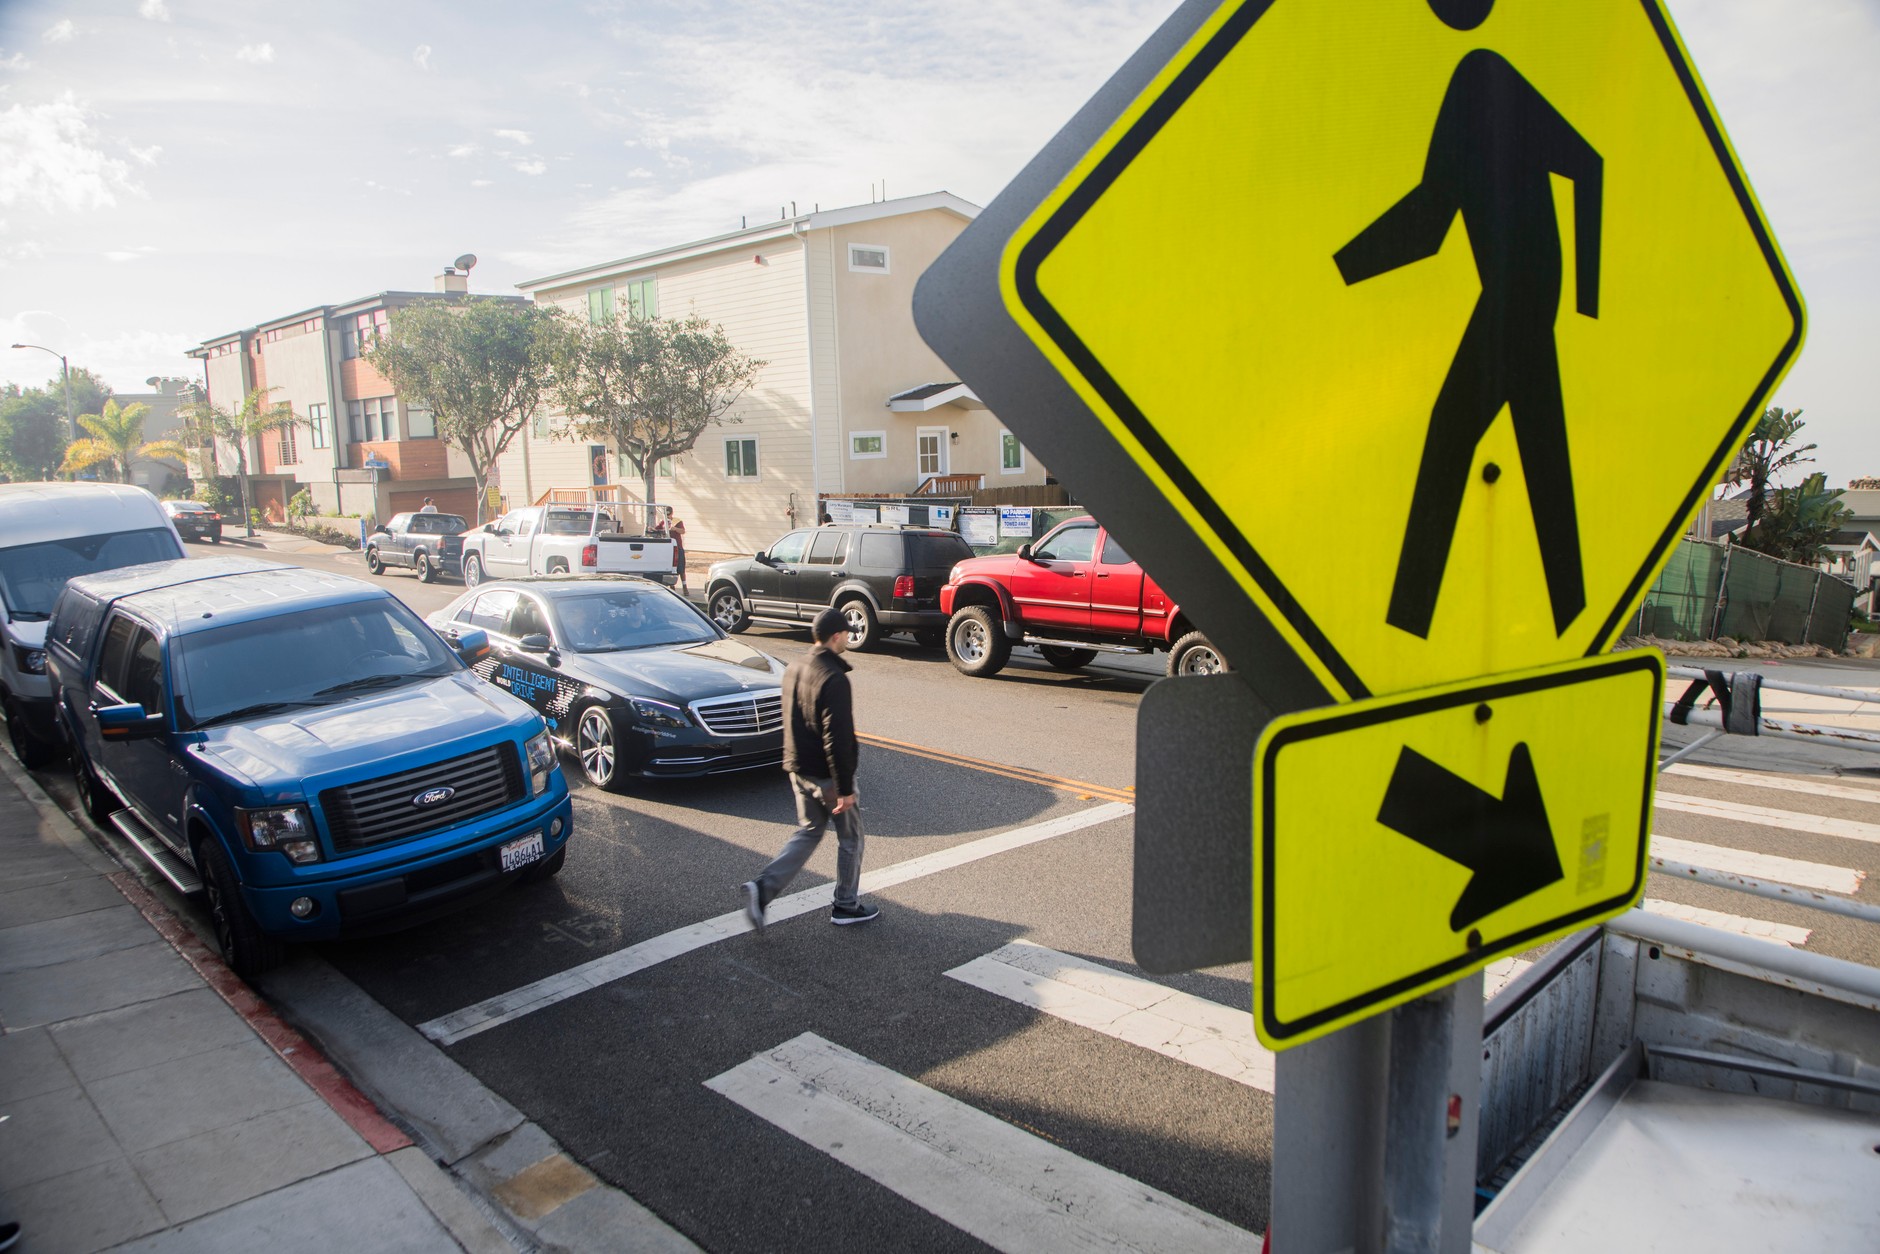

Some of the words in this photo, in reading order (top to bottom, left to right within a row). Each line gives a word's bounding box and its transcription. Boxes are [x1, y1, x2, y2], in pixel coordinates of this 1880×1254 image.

[496, 676, 511, 687] WORLD
[511, 680, 537, 701] DRIVE
[502, 663, 557, 693] INTELLIGENT
[423, 789, 447, 804] Ford
[502, 841, 543, 869] 74864A1
